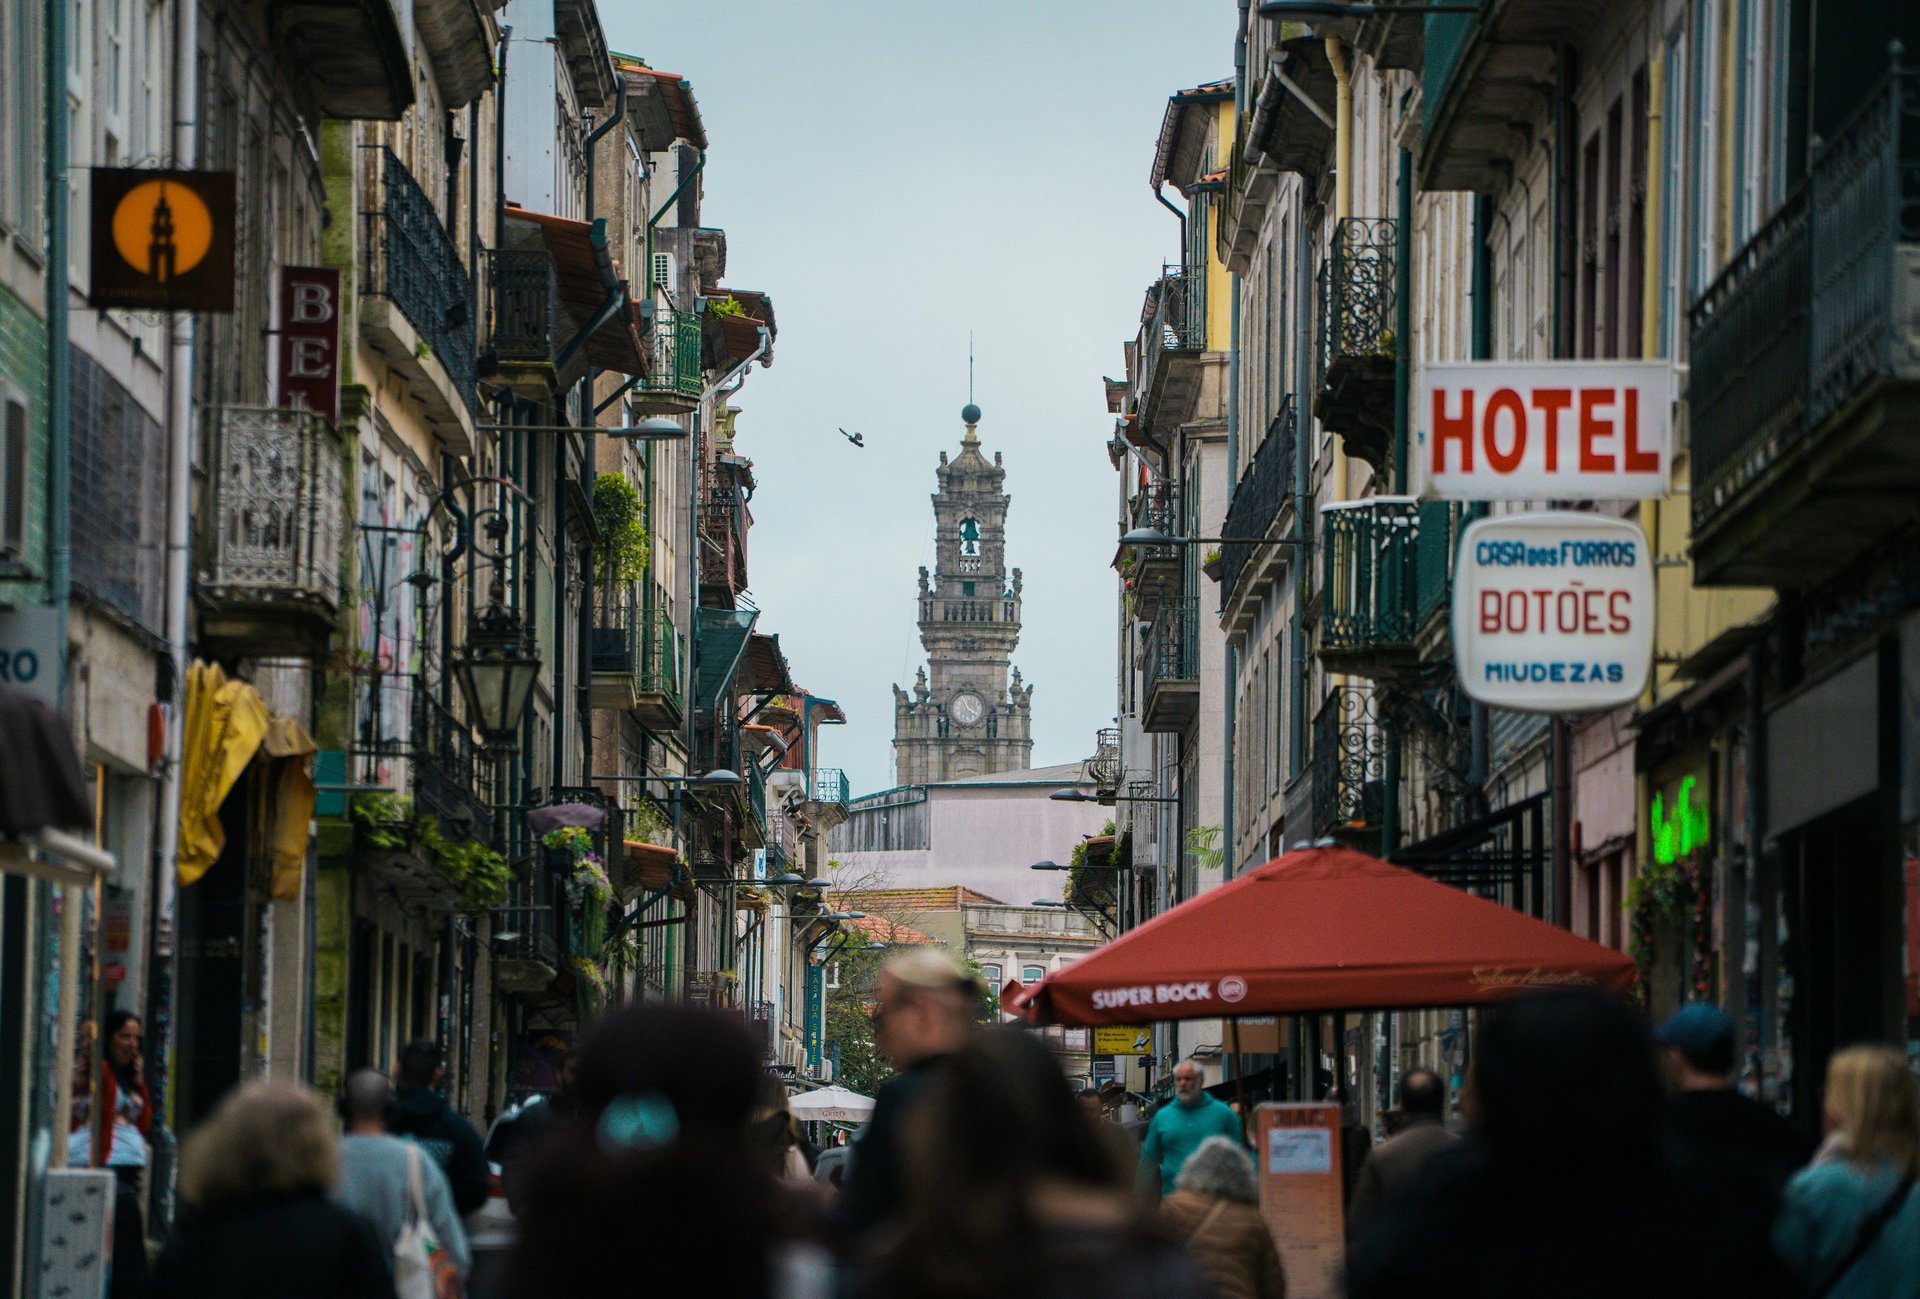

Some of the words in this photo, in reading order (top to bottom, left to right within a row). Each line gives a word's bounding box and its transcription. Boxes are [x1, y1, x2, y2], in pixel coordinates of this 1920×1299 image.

[1431, 387, 1660, 475] HOTEL
[1475, 541, 1526, 567] CASA
[1560, 541, 1636, 567] FORROS
[1479, 580, 1632, 635] BOTÕES
[1484, 662, 1624, 683] MIUDEZAS
[1092, 986, 1153, 1010] SUPER
[1155, 982, 1212, 1003] BOCK
[811, 1003, 820, 1020] DA
